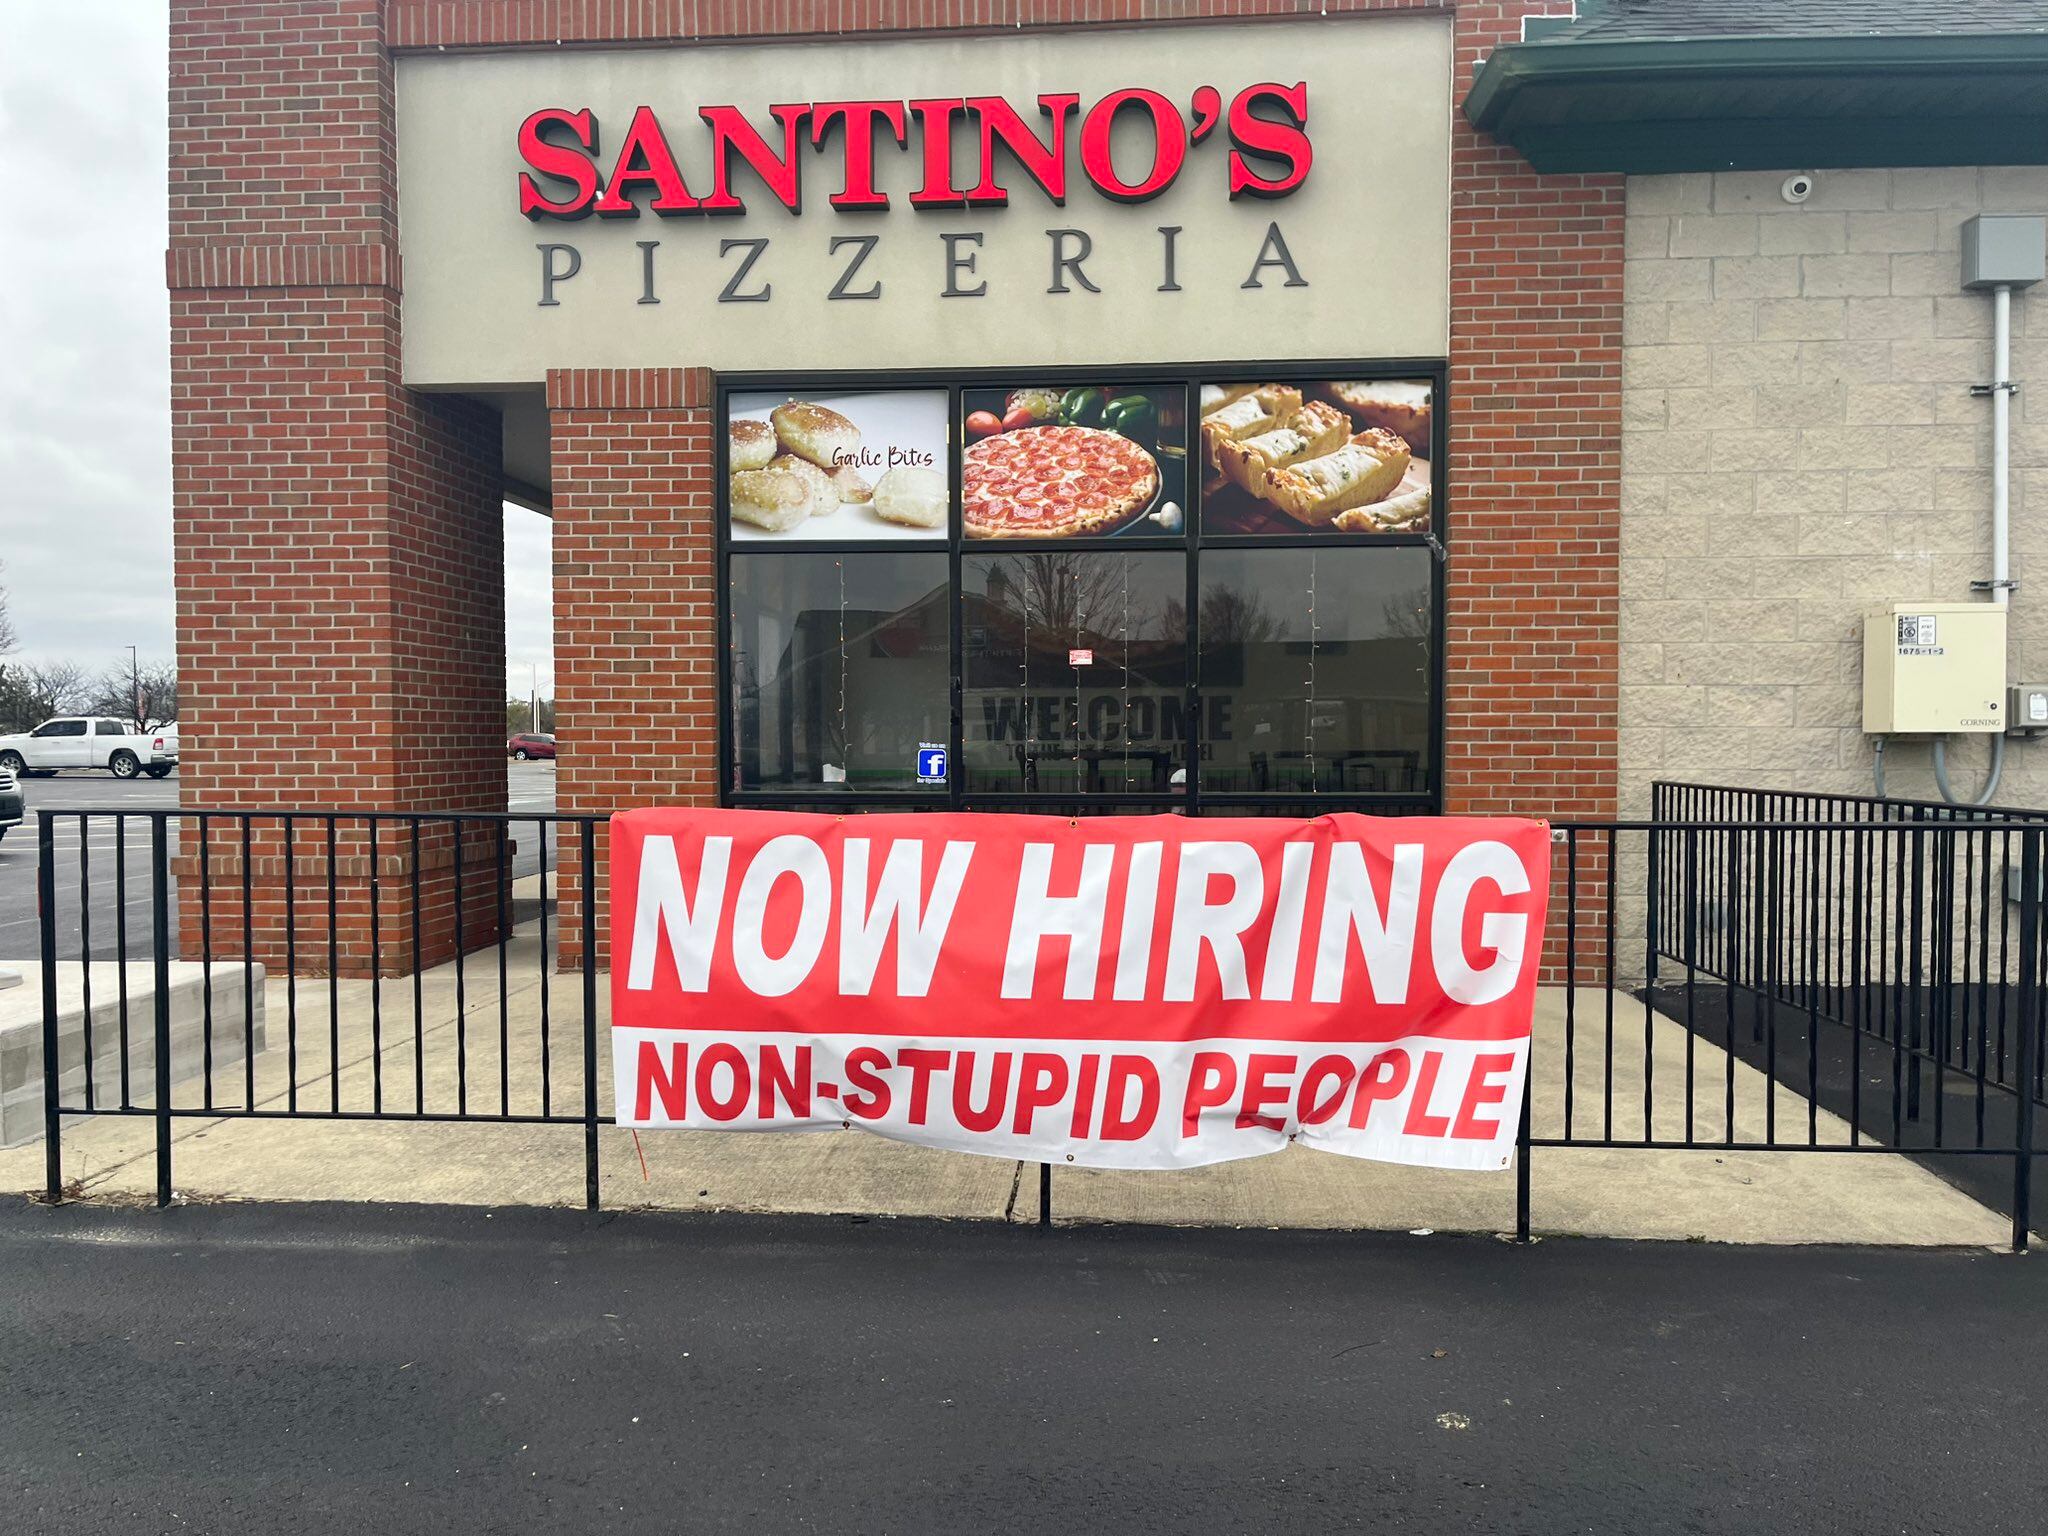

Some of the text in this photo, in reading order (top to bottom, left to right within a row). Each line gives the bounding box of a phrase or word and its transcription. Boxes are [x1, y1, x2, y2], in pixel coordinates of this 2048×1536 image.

[518, 81, 1313, 218] SANTINO'S
[535, 220, 1308, 307] PIZZERIA
[832, 445, 934, 469] Garlic Bites
[982, 695, 1233, 741] WELCOME
[628, 835, 1530, 1005] NOW HIRING
[635, 1041, 1515, 1142] NON-STUPID PEOPLE
